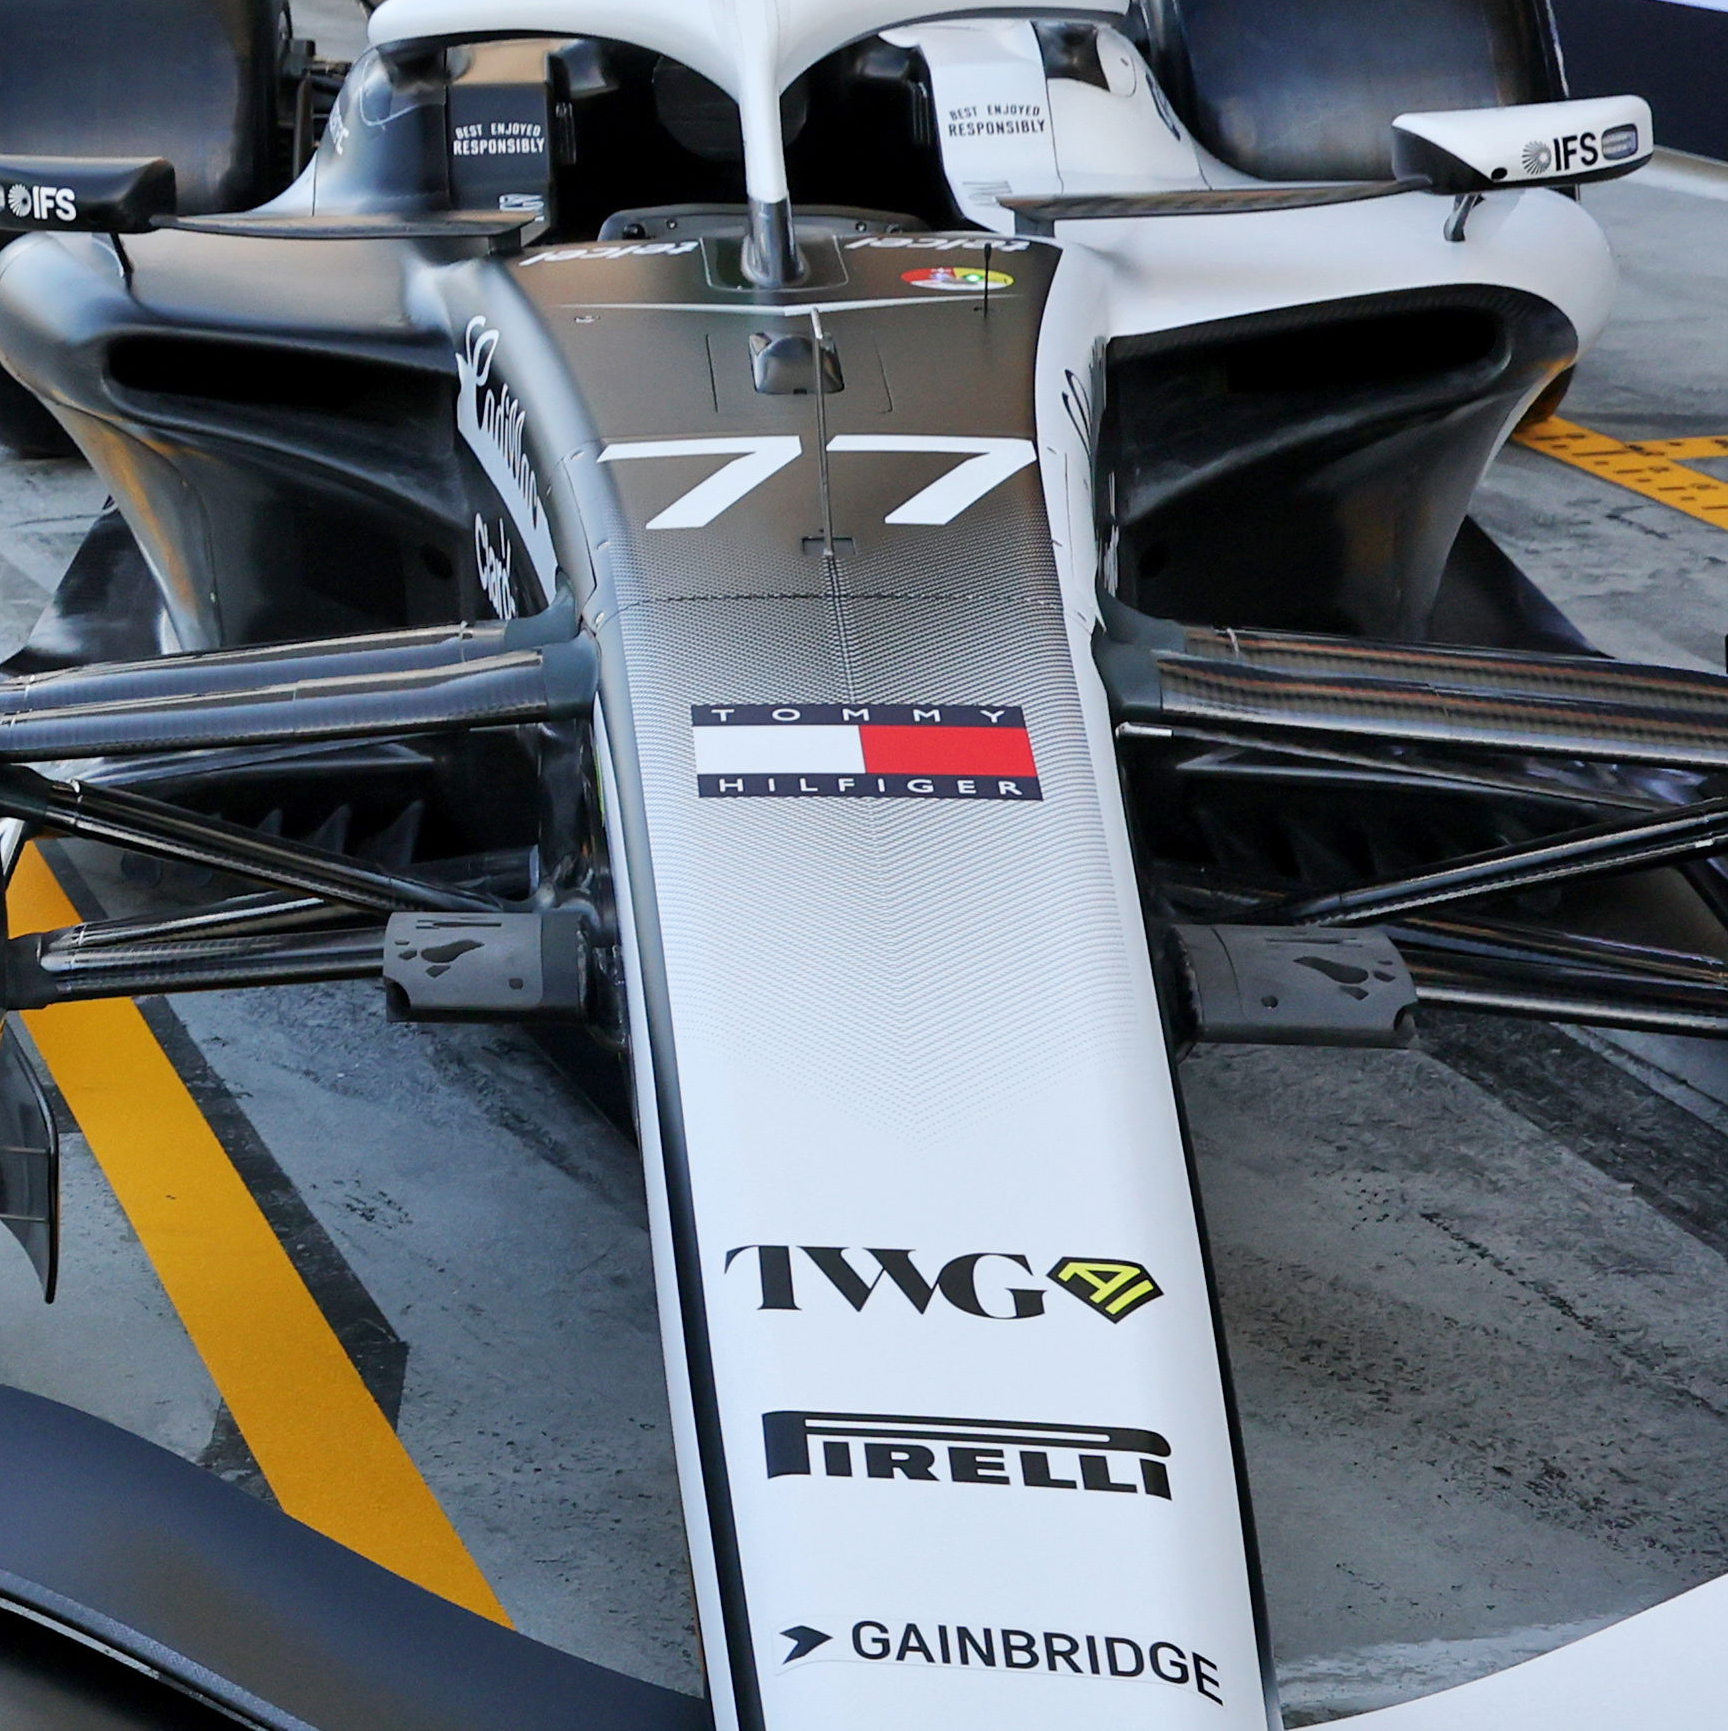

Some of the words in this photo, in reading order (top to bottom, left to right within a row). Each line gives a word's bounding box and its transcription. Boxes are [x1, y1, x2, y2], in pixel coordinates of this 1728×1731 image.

[948, 106, 978, 121] BEST
[987, 103, 1041, 118] ENJOYED
[454, 123, 483, 141] BEST
[489, 121, 542, 138] ENJOYED
[947, 119, 1046, 138] RESPONSIBLY
[452, 136, 545, 157] RESPONSIBLY
[1553, 131, 1599, 172] IFS
[32, 185, 77, 222] IFS
[596, 434, 1038, 529] 77
[711, 707, 1006, 725] TOMMY
[717, 778, 1020, 797] HILFIGER
[724, 1245, 1047, 1319] TWG
[762, 1411, 1173, 1501] PIRELLI
[851, 1620, 1224, 1707] GAINBRIDGE
